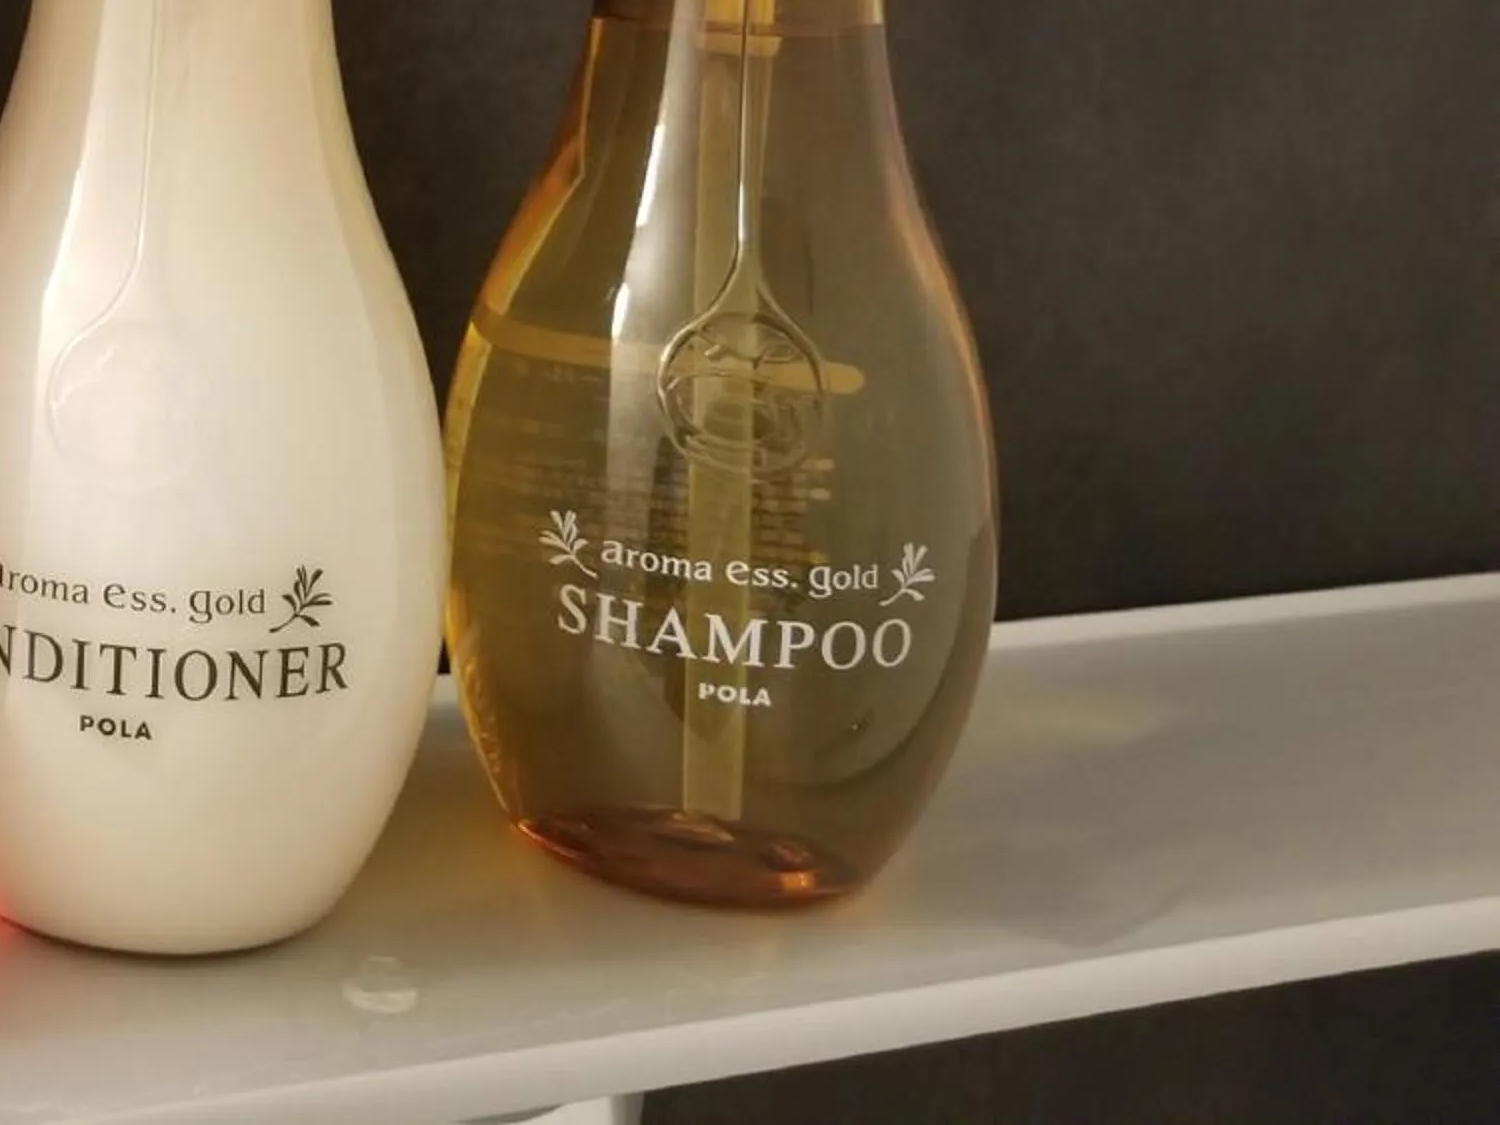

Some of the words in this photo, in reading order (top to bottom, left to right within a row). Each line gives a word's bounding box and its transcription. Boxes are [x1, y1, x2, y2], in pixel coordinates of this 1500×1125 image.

[601, 540, 712, 582] aroma
[726, 559, 798, 589] ess.
[809, 564, 878, 598] gold
[103, 582, 177, 614] ess.
[189, 588, 266, 623] gold
[557, 584, 912, 670] SHAMPOO
[698, 682, 772, 707] POLA
[79, 714, 152, 741] POLA
